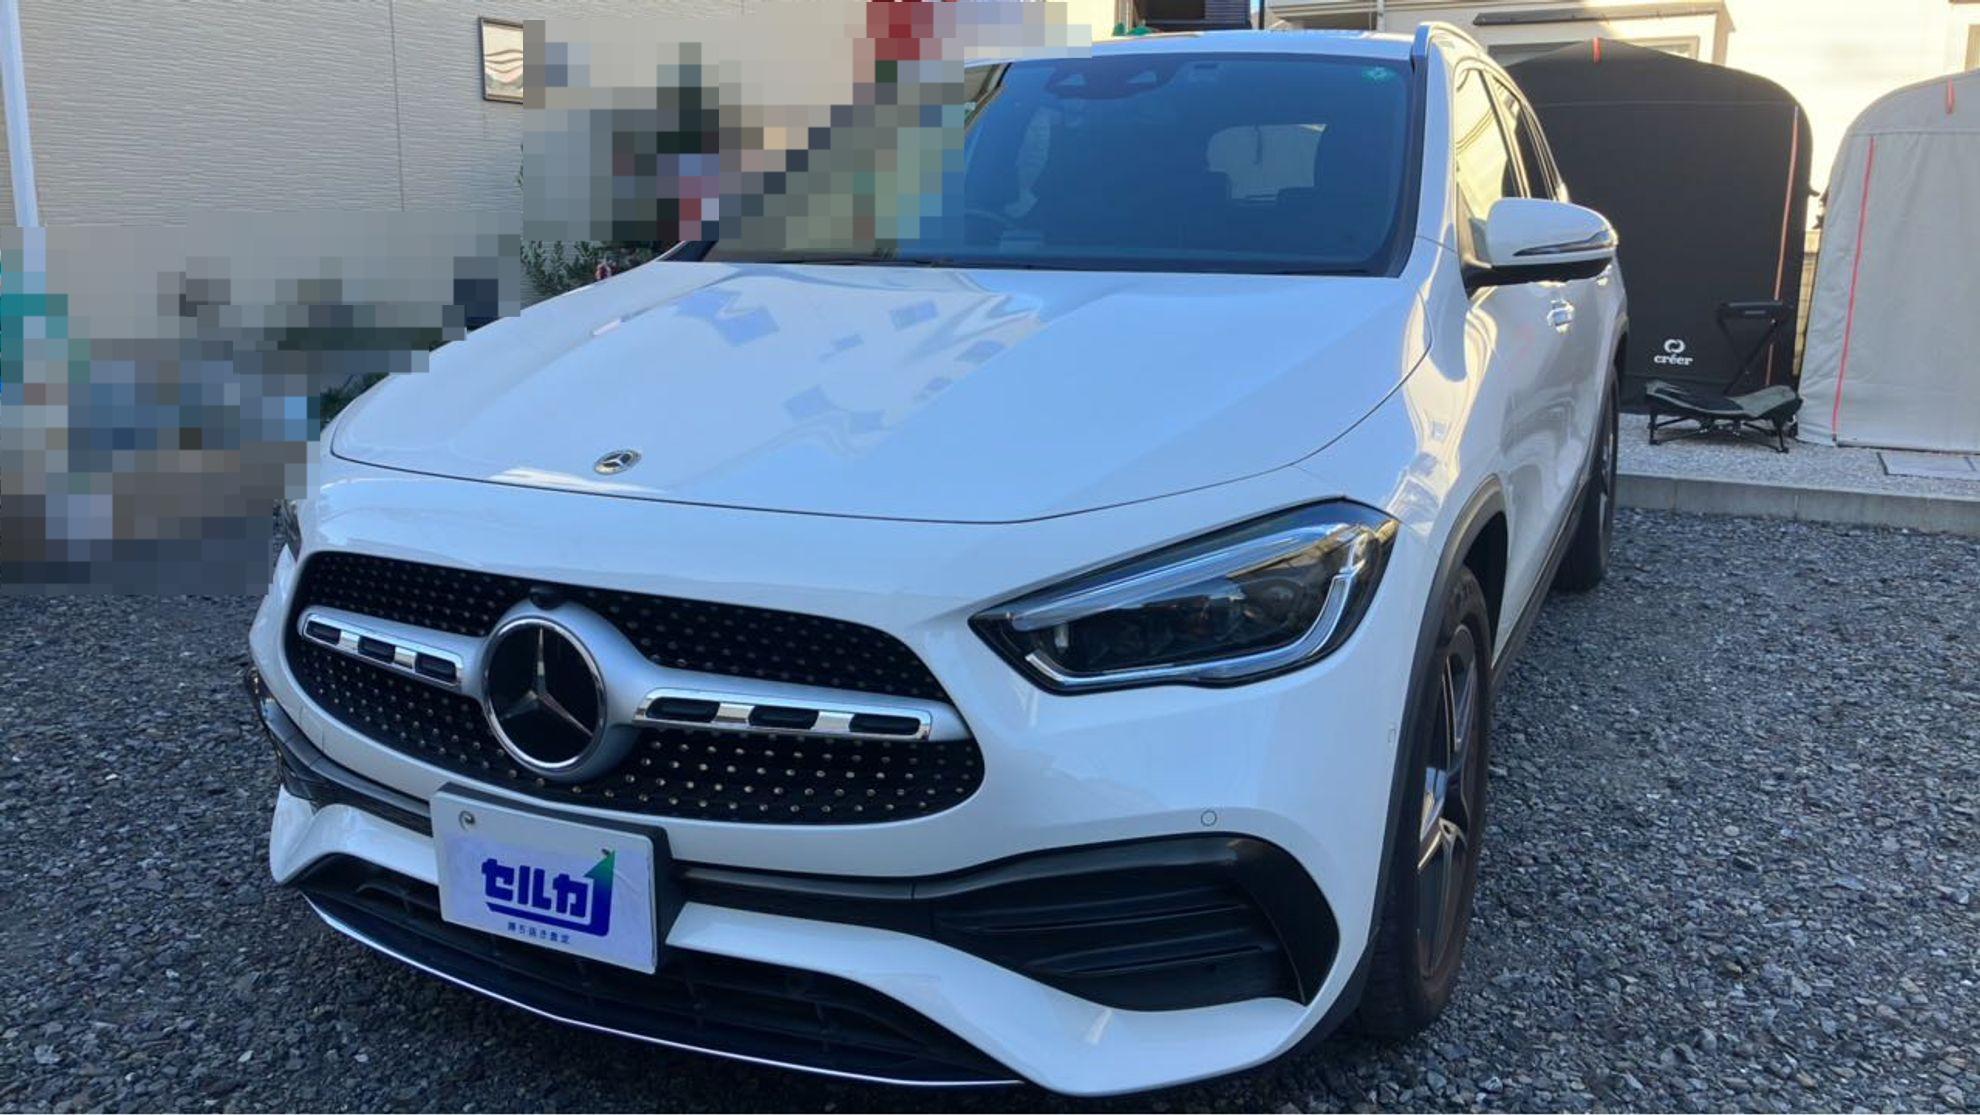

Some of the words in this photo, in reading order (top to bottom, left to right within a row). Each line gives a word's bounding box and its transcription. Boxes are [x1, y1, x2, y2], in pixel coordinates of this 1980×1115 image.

[1653, 353, 1693, 366] créer
[481, 858, 589, 918] セルカ
